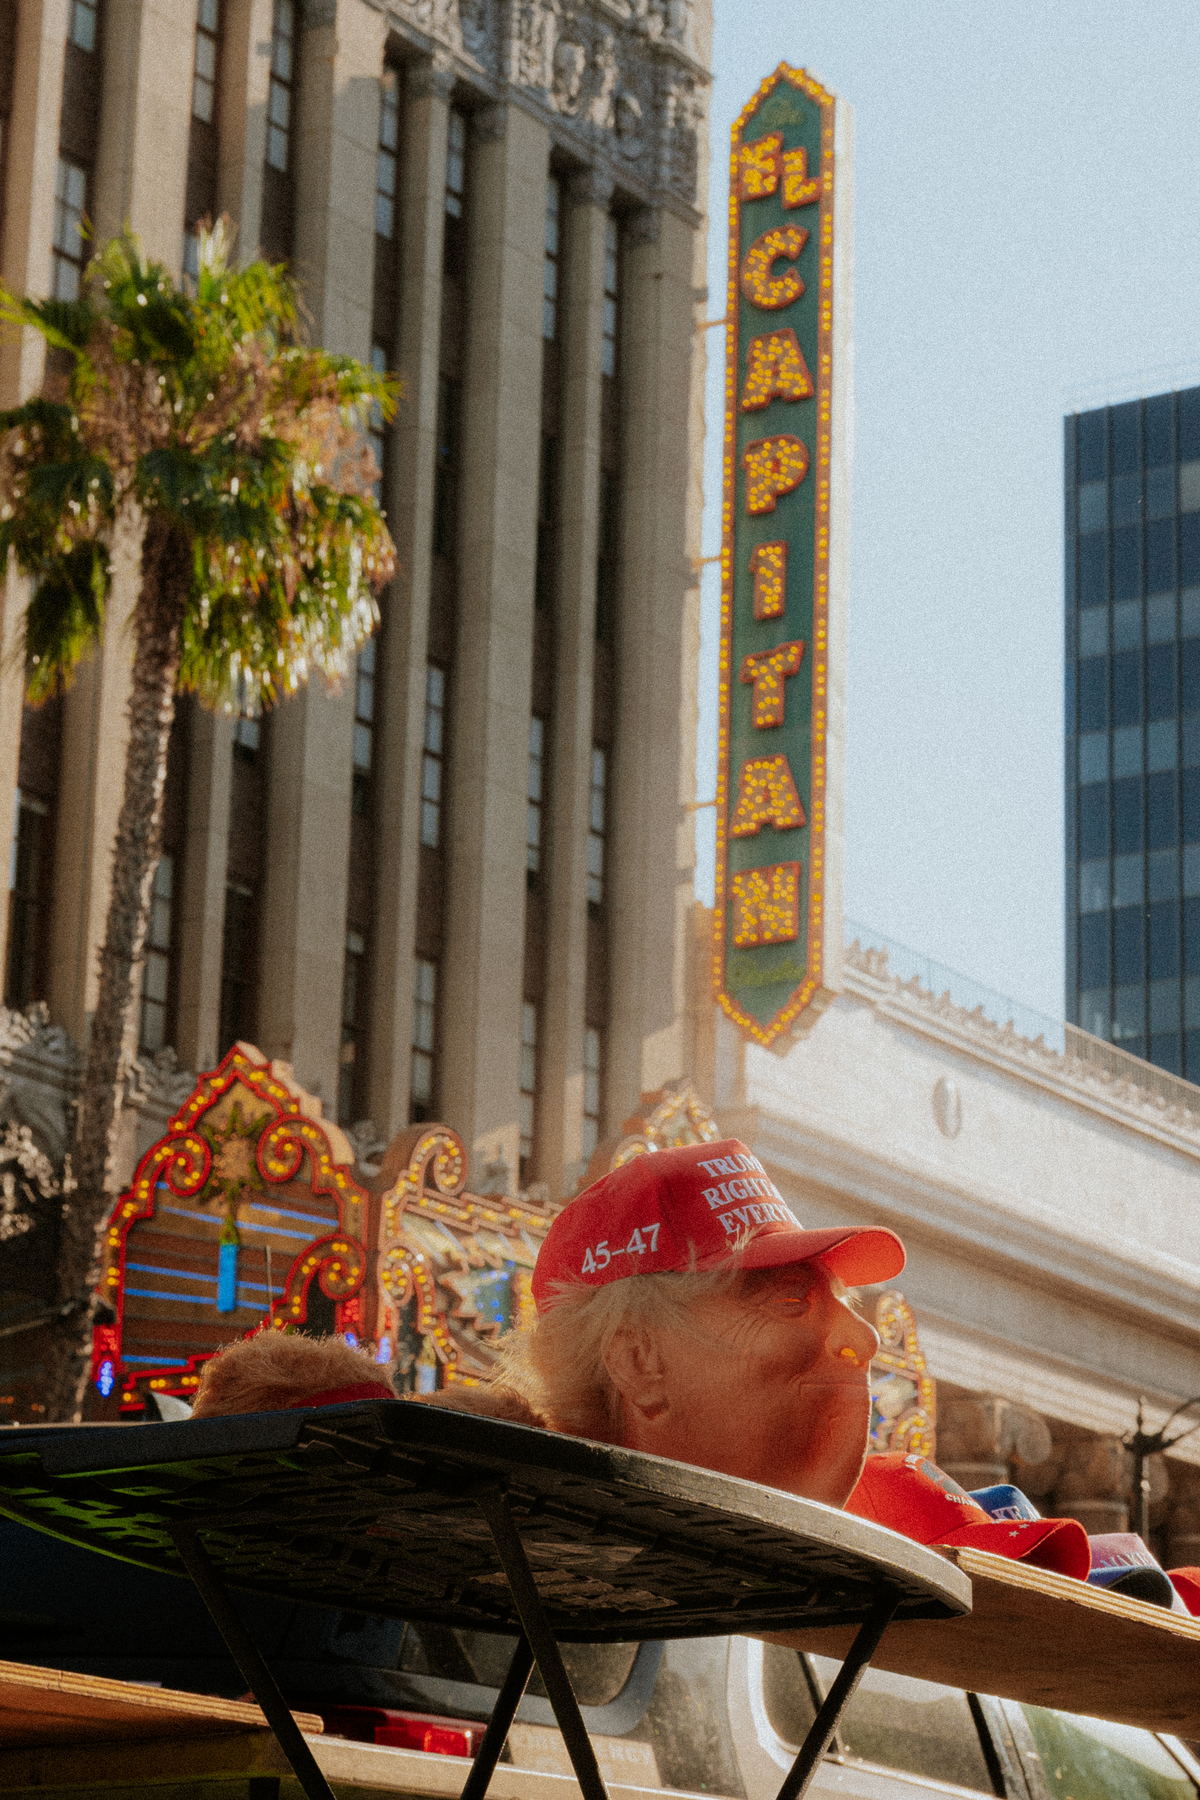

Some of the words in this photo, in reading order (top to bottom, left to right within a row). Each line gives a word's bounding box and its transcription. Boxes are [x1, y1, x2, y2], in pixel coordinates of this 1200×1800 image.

[739, 132, 821, 210] EL
[729, 224, 814, 949] CAPITAN
[701, 1178, 775, 1210] RIGHT
[716, 1203, 804, 1235] EVERY
